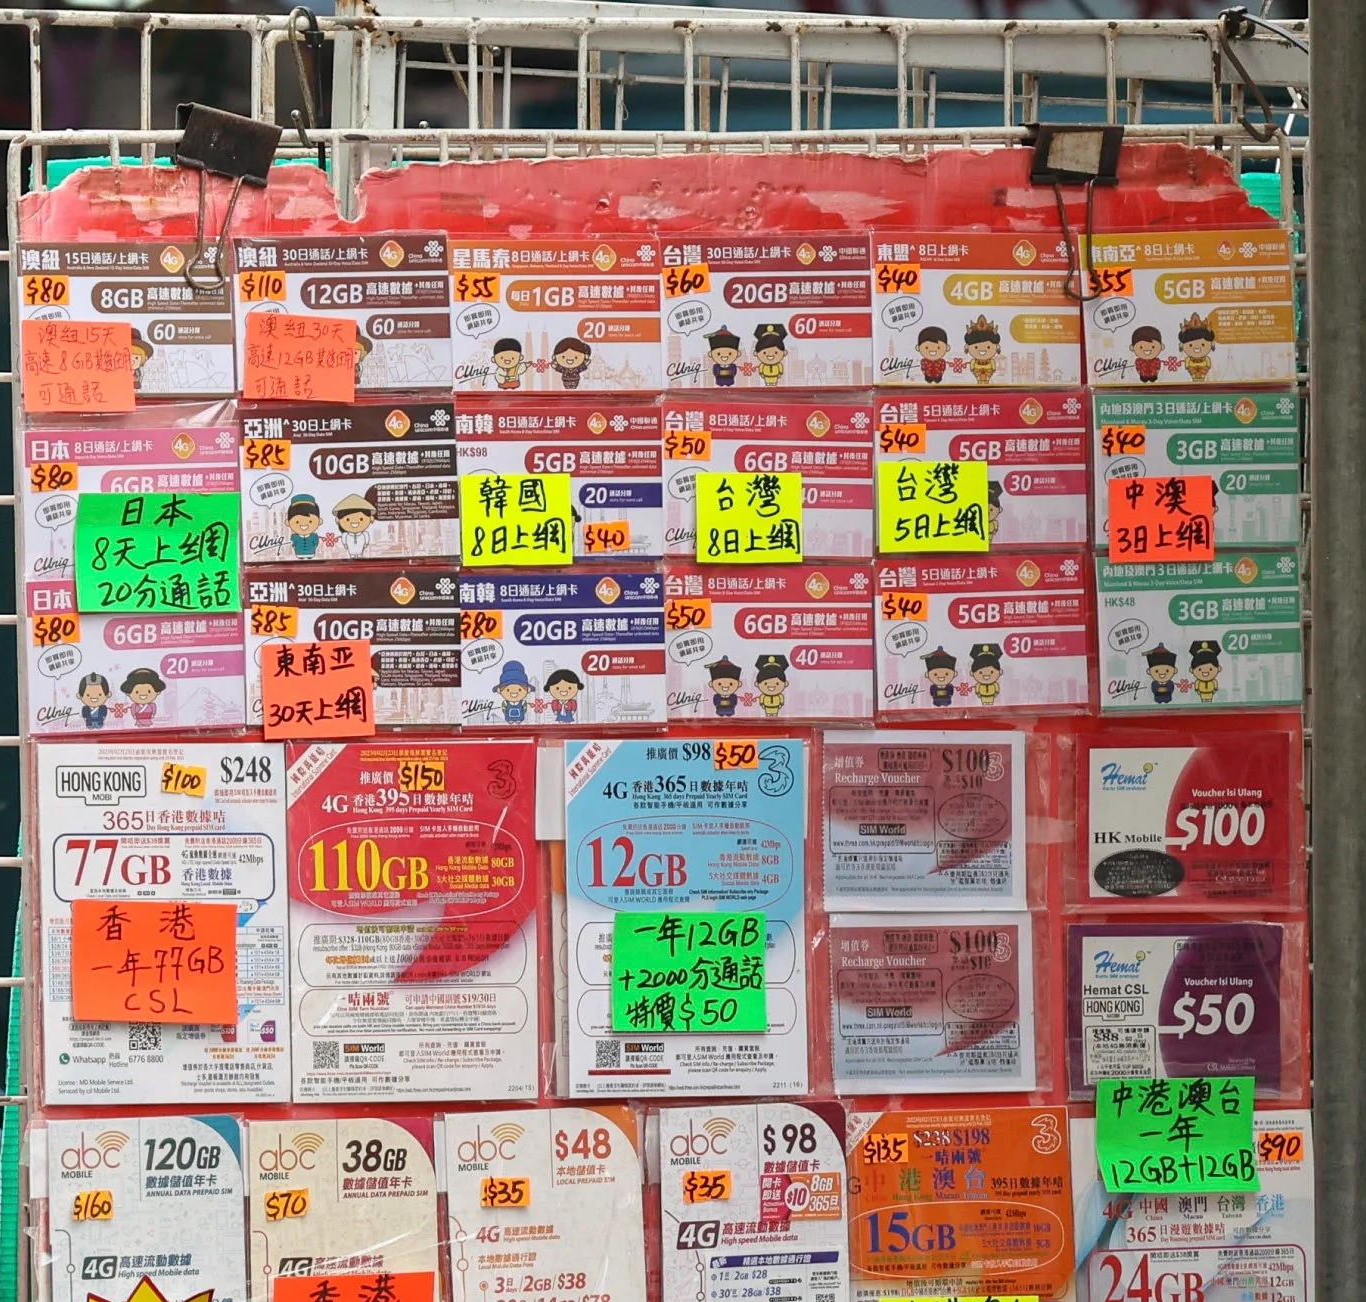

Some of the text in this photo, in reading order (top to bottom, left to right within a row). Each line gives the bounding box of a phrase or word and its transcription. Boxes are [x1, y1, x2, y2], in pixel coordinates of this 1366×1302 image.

[25, 277, 67, 303] $80
[241, 273, 283, 300] $110
[306, 280, 364, 305] 12GB
[532, 282, 576, 307] 1GB
[666, 269, 706, 294] $60
[100, 285, 144, 311] 8GB
[153, 320, 175, 342] 60
[244, 441, 288, 467] $85
[312, 449, 370, 475] 10GB
[120, 496, 193, 525] 日本
[519, 618, 578, 642] 20GB
[682, 742, 711, 762] $98
[715, 744, 756, 767] $50
[61, 770, 142, 793] HONG KONG
[220, 756, 271, 784] $248
[835, 772, 920, 784] Recharge Voucher
[1192, 788, 1262, 799] Voucher Isi Ulang
[1094, 832, 1162, 844] HK Mobile
[1175, 808, 1266, 851] $100
[66, 839, 171, 886] 77GB
[309, 839, 429, 893] 110GB
[587, 836, 688, 888] 12GB
[98, 906, 196, 941] 香港
[1083, 985, 1149, 995] Hemat CSL
[1172, 993, 1255, 1039] $50
[73, 1054, 106, 1065] Whatsapp
[555, 1128, 612, 1160] $48
[763, 1123, 817, 1154] $98
[144, 1137, 221, 1170] 120GB
[342, 1139, 407, 1173] 38GB
[267, 1191, 307, 1217] $70
